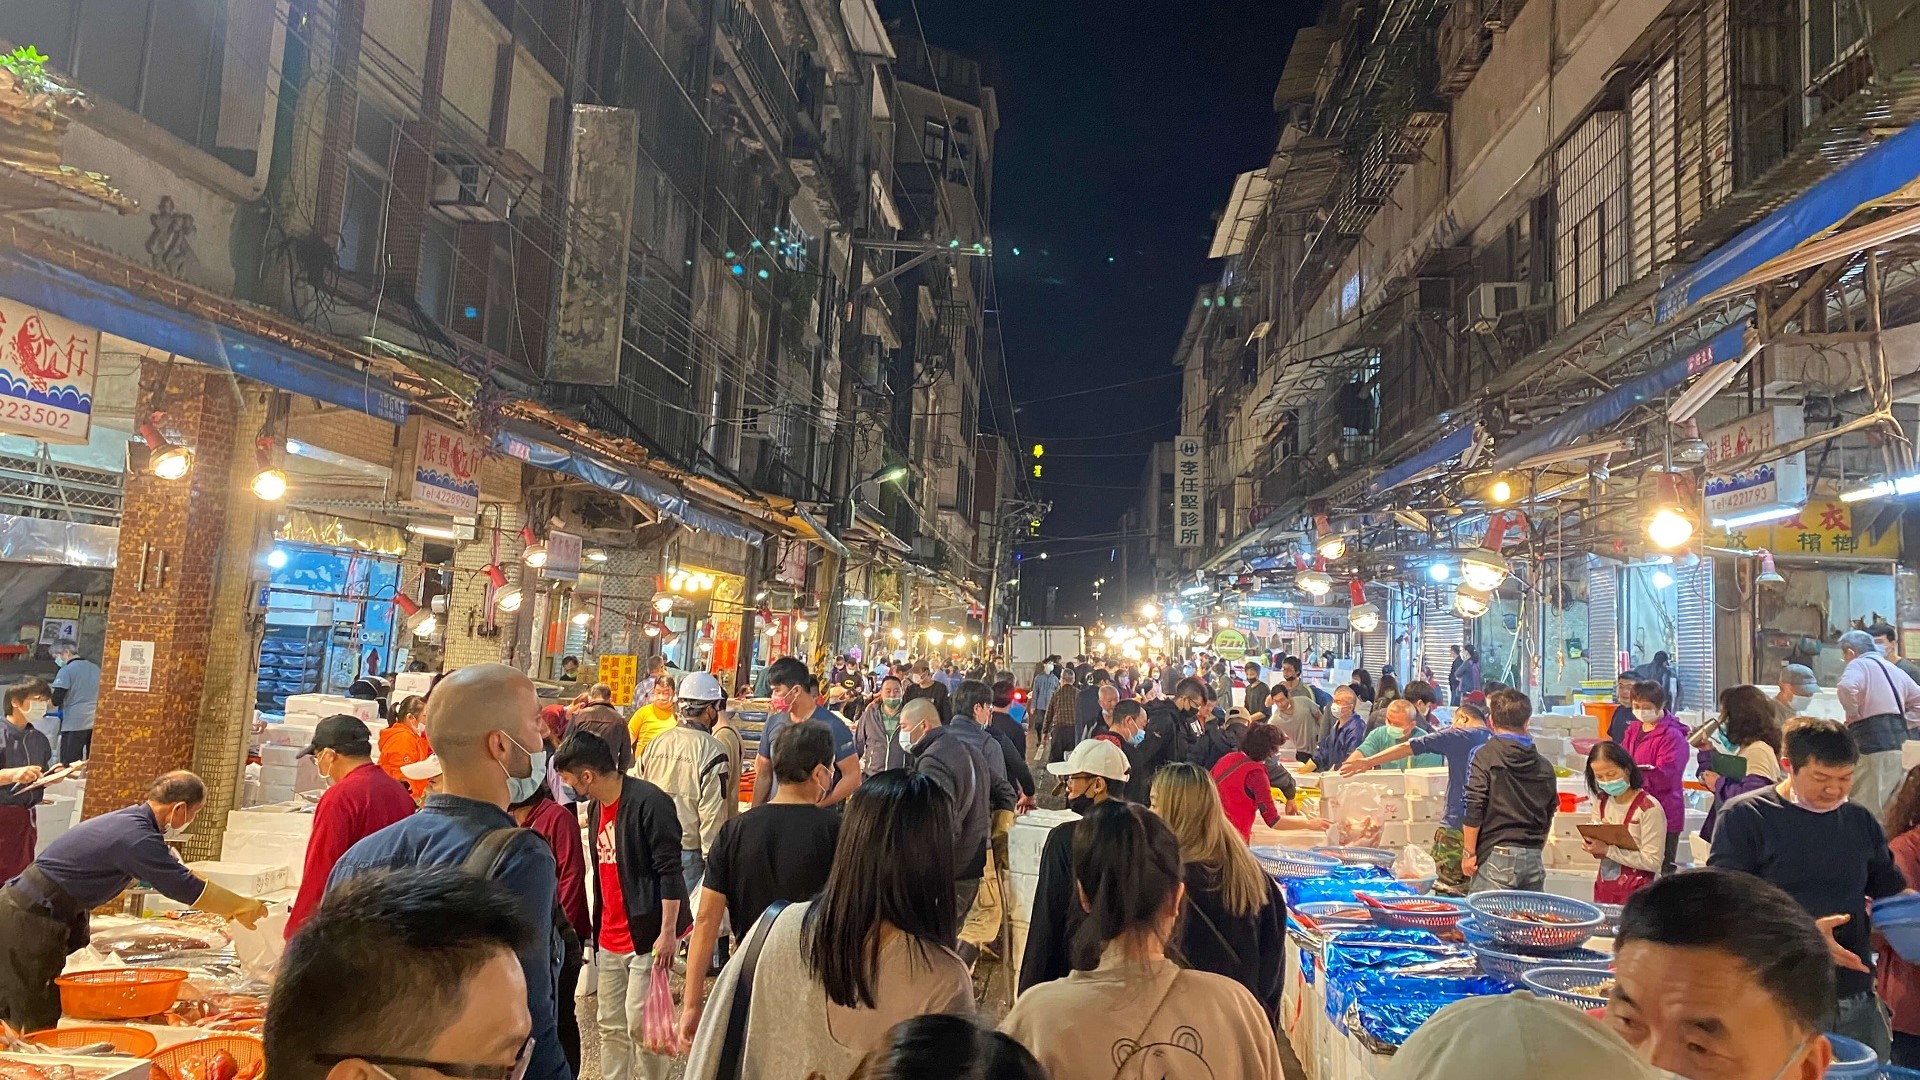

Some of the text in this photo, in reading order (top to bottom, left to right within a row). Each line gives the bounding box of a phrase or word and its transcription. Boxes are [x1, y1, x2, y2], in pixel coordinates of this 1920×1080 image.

[67, 334, 89, 376] 行
[1180, 461, 1199, 544] 李任堅診所
[1797, 532, 1858, 553] 檳榔
[64, 624, 73, 635] 4
